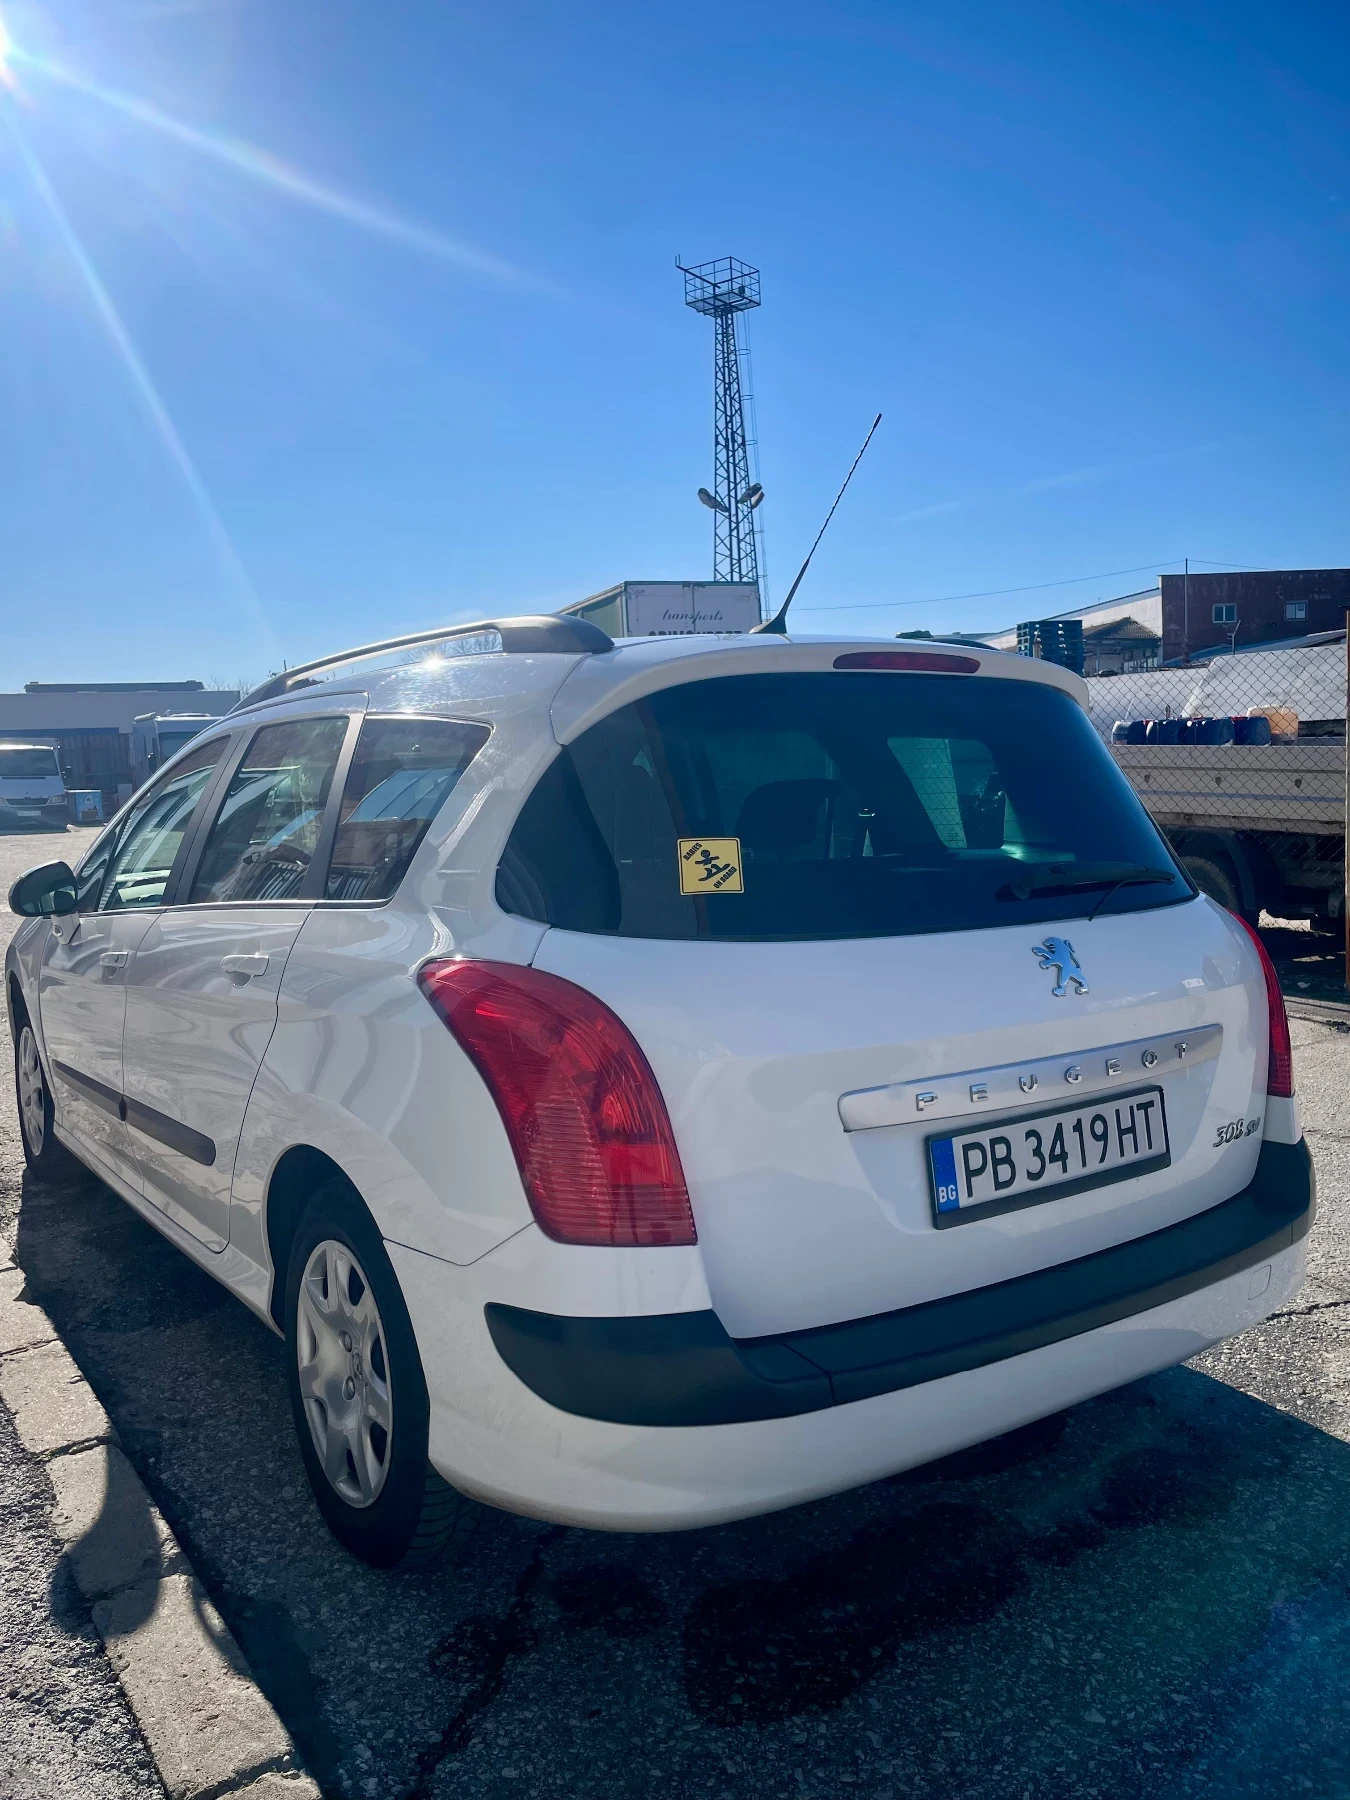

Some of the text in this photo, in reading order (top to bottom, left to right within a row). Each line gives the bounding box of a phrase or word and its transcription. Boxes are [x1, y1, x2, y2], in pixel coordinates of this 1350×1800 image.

[662, 609, 723, 624] transports
[915, 1042, 1189, 1112] PEUGEOT
[1213, 1118, 1244, 1147] 308
[962, 1136, 1017, 1198] PB
[938, 1184, 957, 1203] BG
